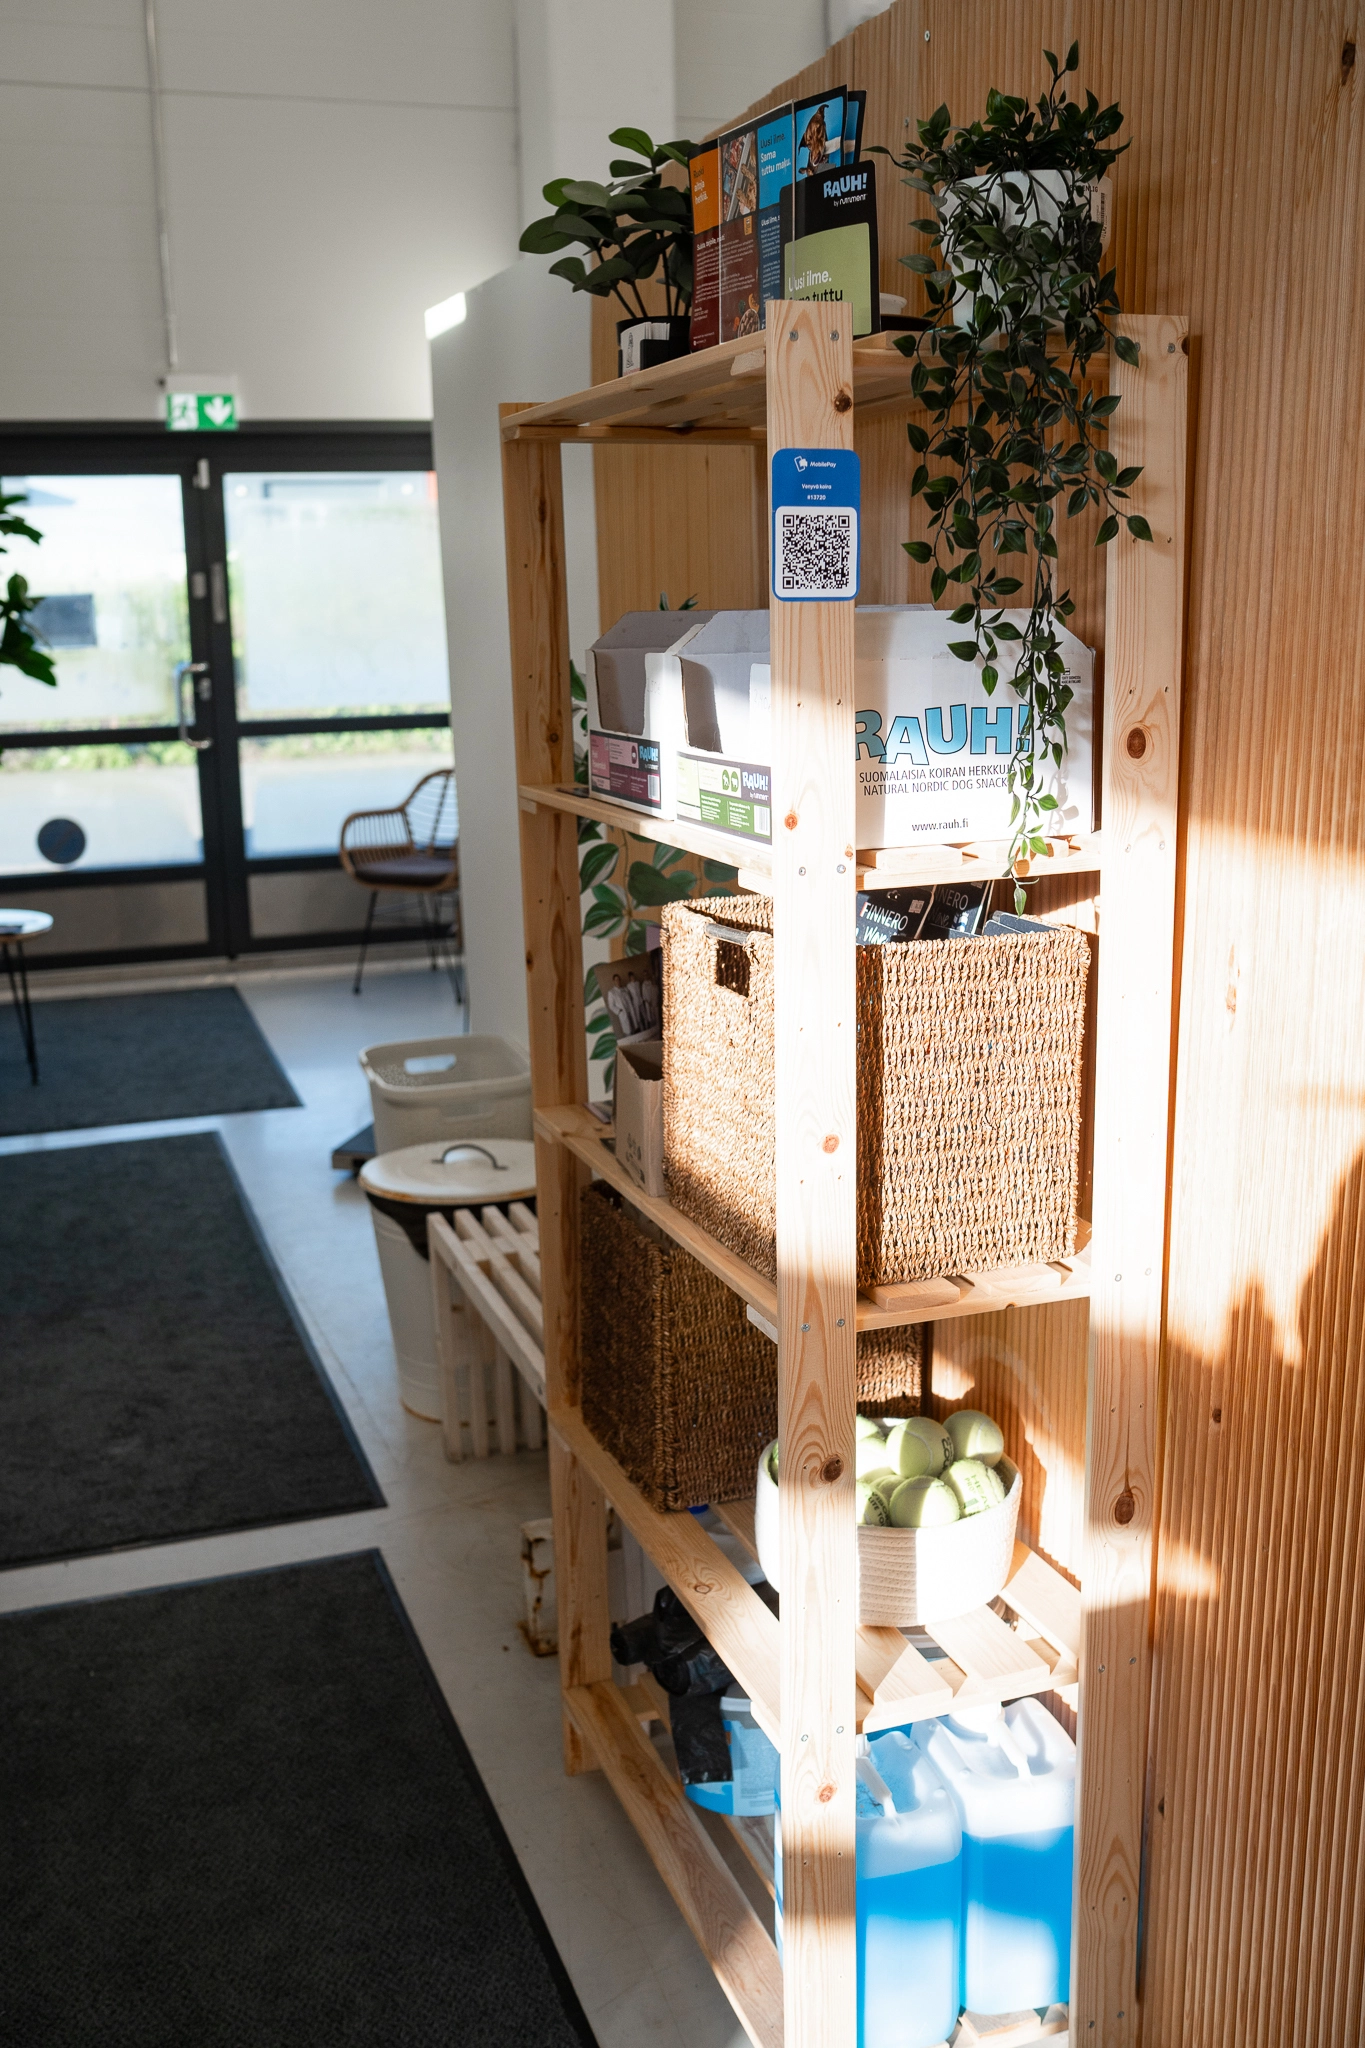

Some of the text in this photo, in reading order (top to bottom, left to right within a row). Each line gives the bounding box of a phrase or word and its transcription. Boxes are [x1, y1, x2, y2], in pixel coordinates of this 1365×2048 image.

[760, 150, 776, 163] Sama
[823, 172, 868, 199] RAUH!
[833, 199, 840, 207] by
[788, 273, 806, 292] Uusi
[806, 269, 832, 288] ilme.
[812, 288, 844, 302] tuttu
[855, 703, 1031, 766] RAUH!
[638, 745, 660, 762] RAUH!
[741, 771, 769, 791] RAUH!
[859, 769, 927, 783] SUOMALAISIA
[929, 766, 966, 780] KOIRAN
[863, 776, 1009, 796] NATURAL NORDIC DOG SNACK
[911, 817, 970, 832] www.rauh.fi
[859, 901, 909, 931] FINNERO
